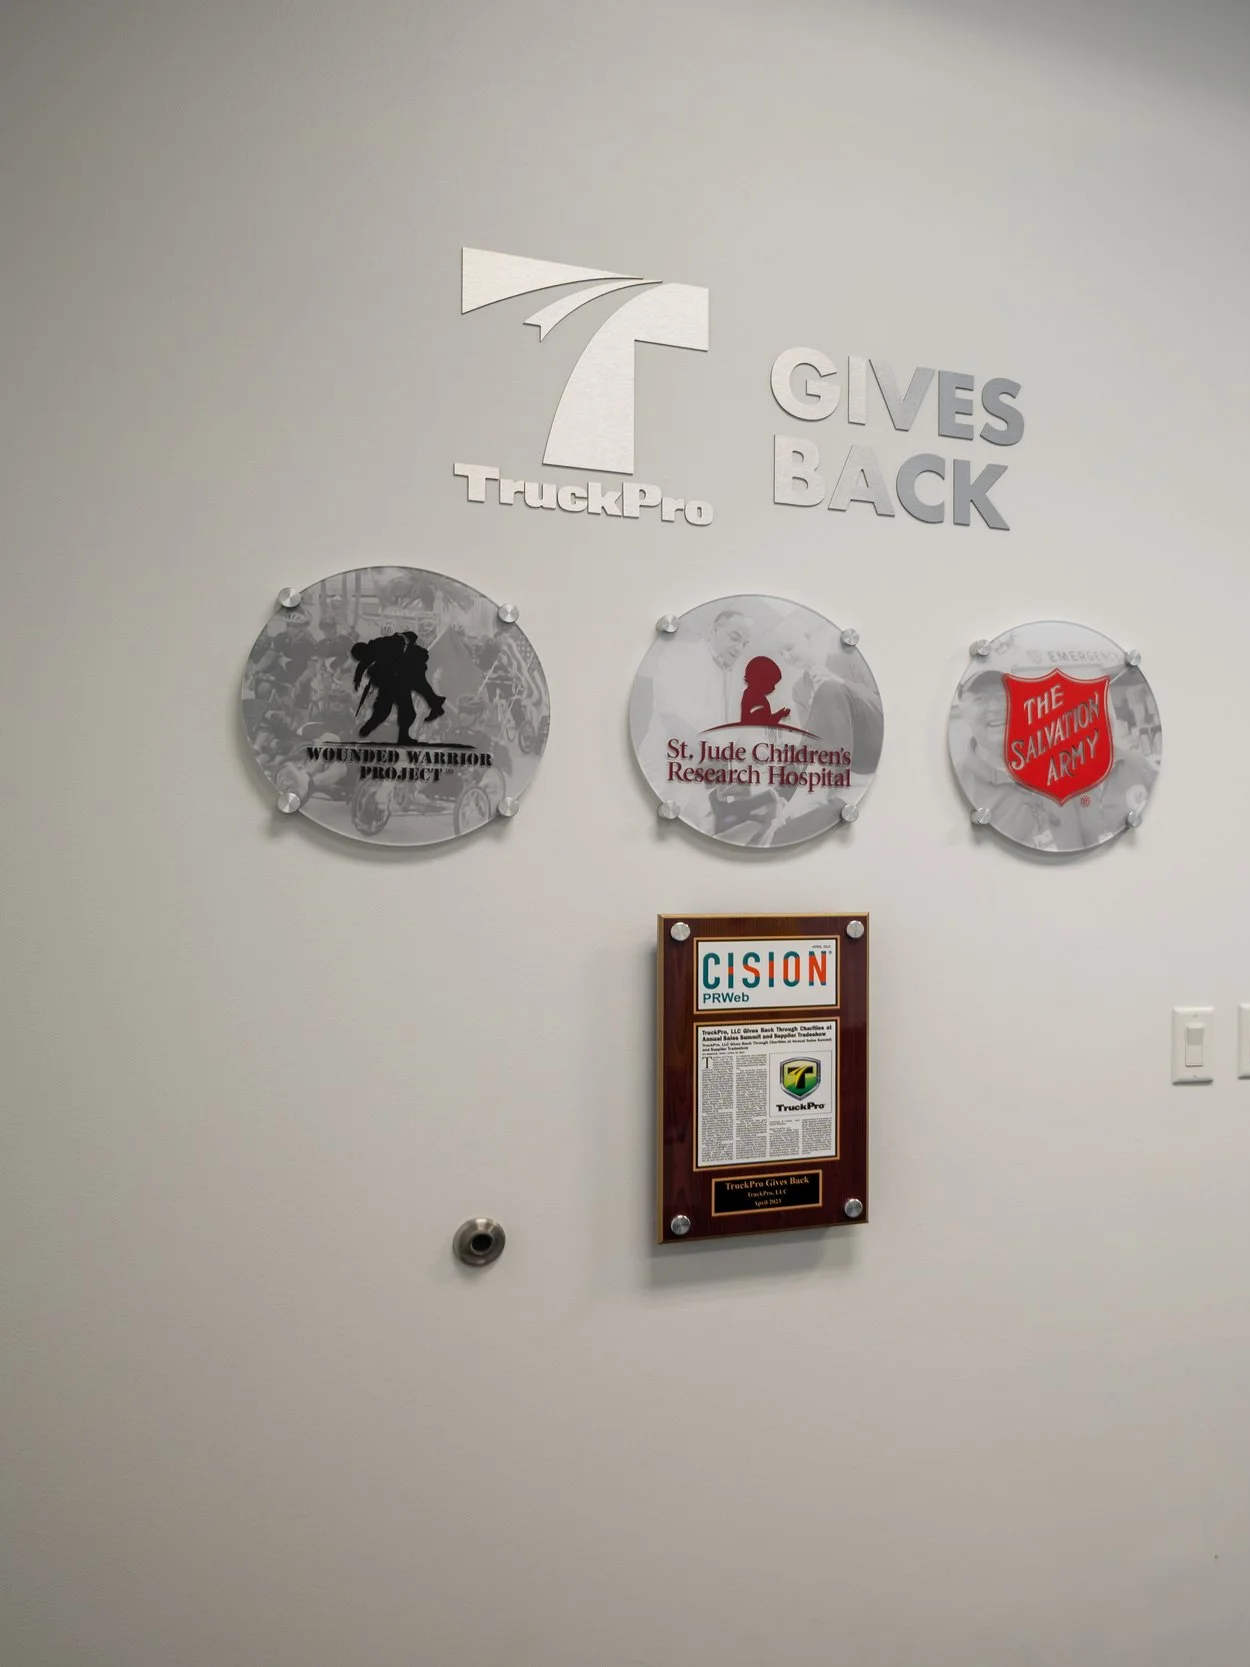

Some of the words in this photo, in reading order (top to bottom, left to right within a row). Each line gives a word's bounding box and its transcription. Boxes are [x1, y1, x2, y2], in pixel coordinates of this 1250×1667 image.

[770, 346, 1025, 446] GIVES
[453, 462, 713, 526] TruckPro
[773, 434, 1010, 530] BACK
[1023, 684, 1064, 725] THE
[1011, 692, 1099, 770] SALVATION
[306, 747, 399, 766] WOUNDED
[407, 750, 492, 767] WARRIOR
[667, 739, 693, 760] St.
[699, 741, 746, 763] Jude
[752, 742, 851, 766] Children's
[1047, 728, 1099, 785] ARMY
[667, 762, 760, 784] Research
[768, 765, 851, 792] Hospital
[703, 951, 826, 989] CISION
[703, 992, 749, 1004] PRWeb
[776, 1102, 825, 1112] TruckPro
[725, 1181, 763, 1190] TruckPro
[790, 1176, 809, 1185] Back
